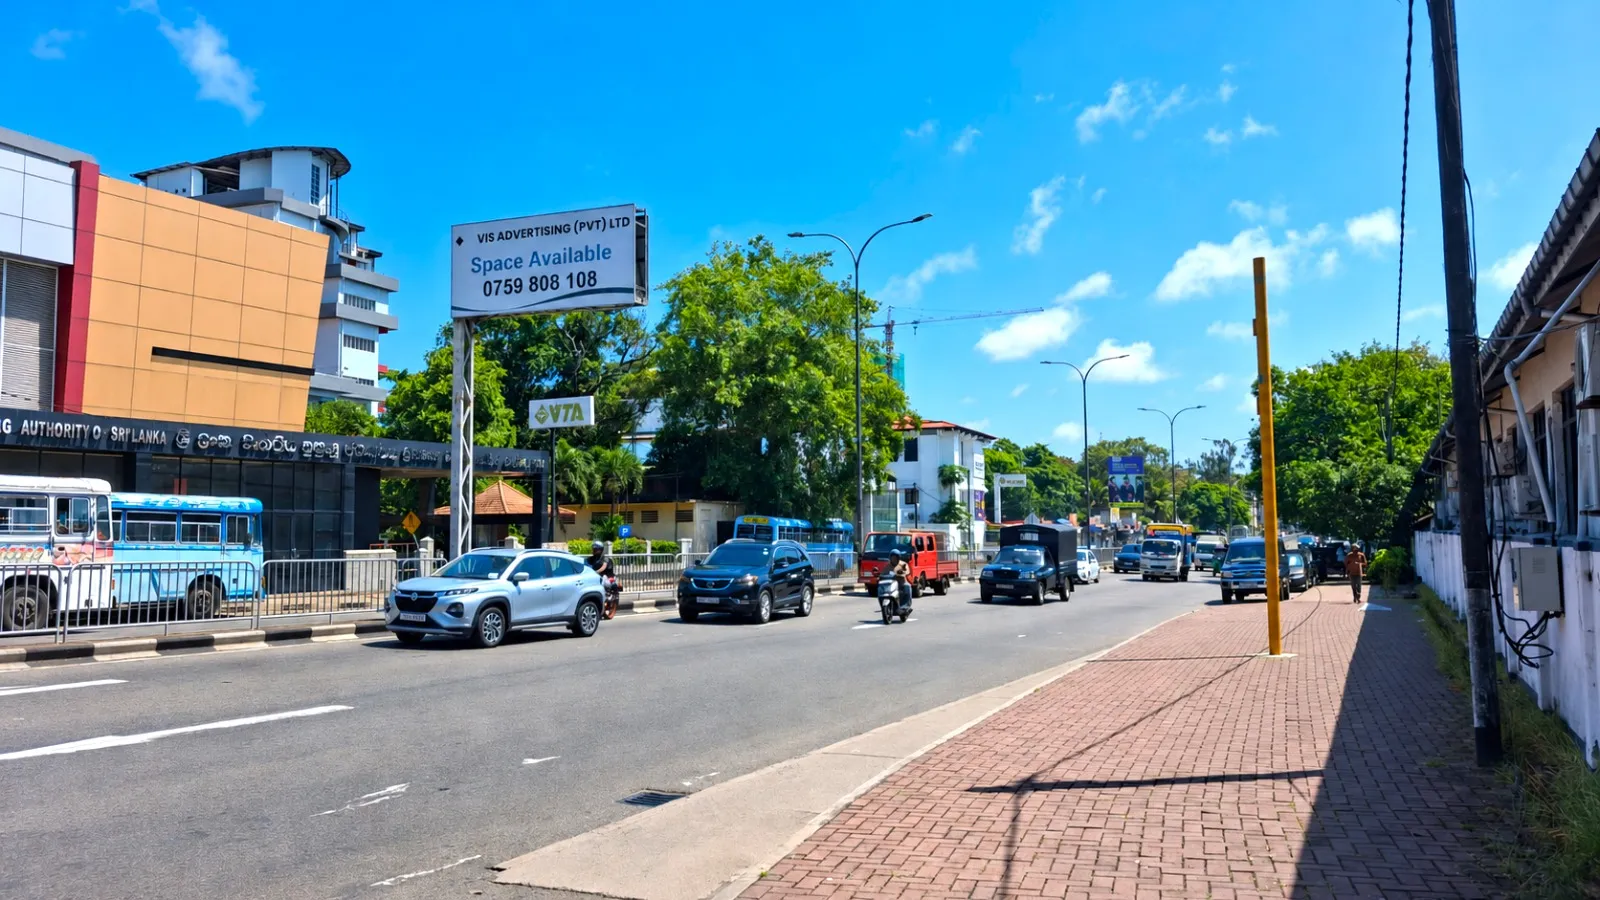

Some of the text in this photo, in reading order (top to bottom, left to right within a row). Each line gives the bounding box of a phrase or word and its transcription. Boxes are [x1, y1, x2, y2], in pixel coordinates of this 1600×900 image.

[477, 216, 631, 244] VIS ADVERTISING (PVT) LTD
[471, 244, 612, 276] Space Available
[483, 270, 598, 297] 0759 808 108
[548, 402, 585, 424] VTA
[0, 417, 12, 434] G
[20, 419, 90, 439] AUTHORITY
[131, 427, 168, 445] LANKA
